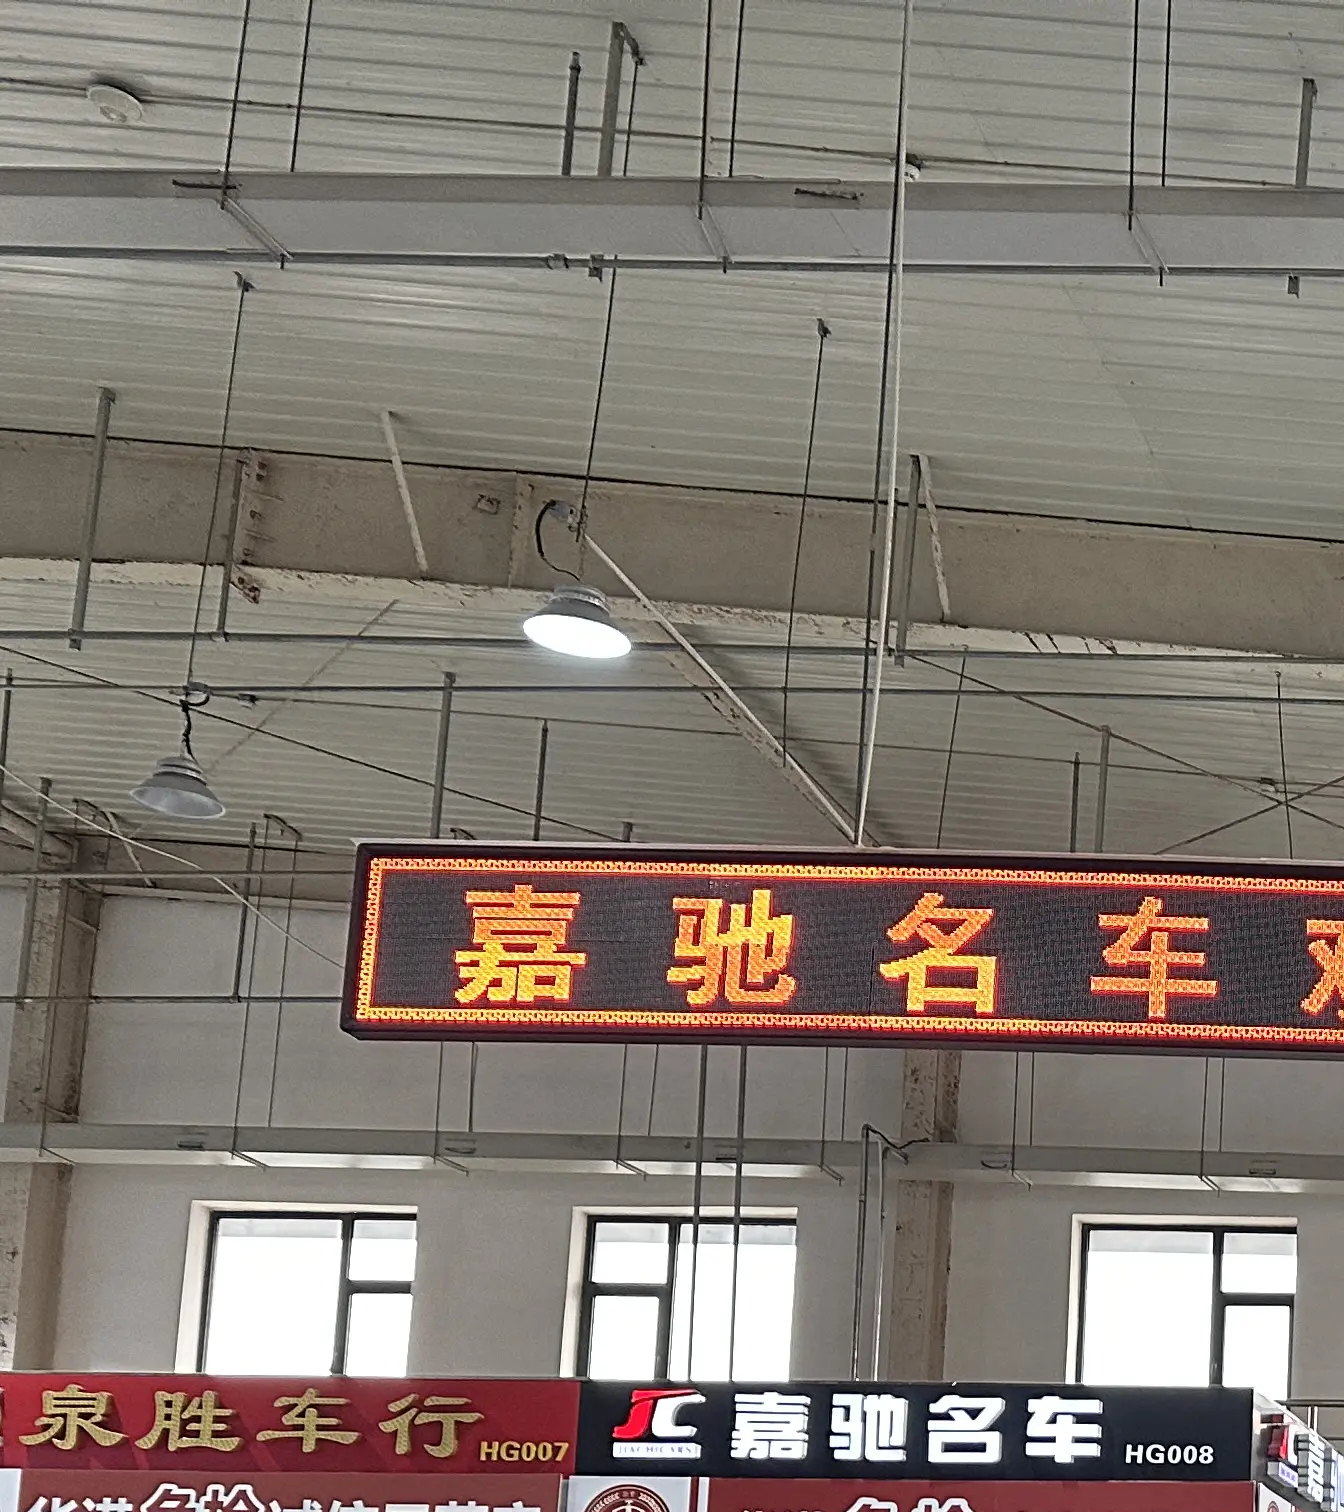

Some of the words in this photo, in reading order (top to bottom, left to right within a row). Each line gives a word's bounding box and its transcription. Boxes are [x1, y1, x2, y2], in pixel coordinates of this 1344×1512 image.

[18, 1383, 485, 1459] 泉胜车行
[729, 1391, 1104, 1464] 嘉驰名车
[479, 1440, 568, 1463] HG007
[1125, 1443, 1215, 1465] HG008
